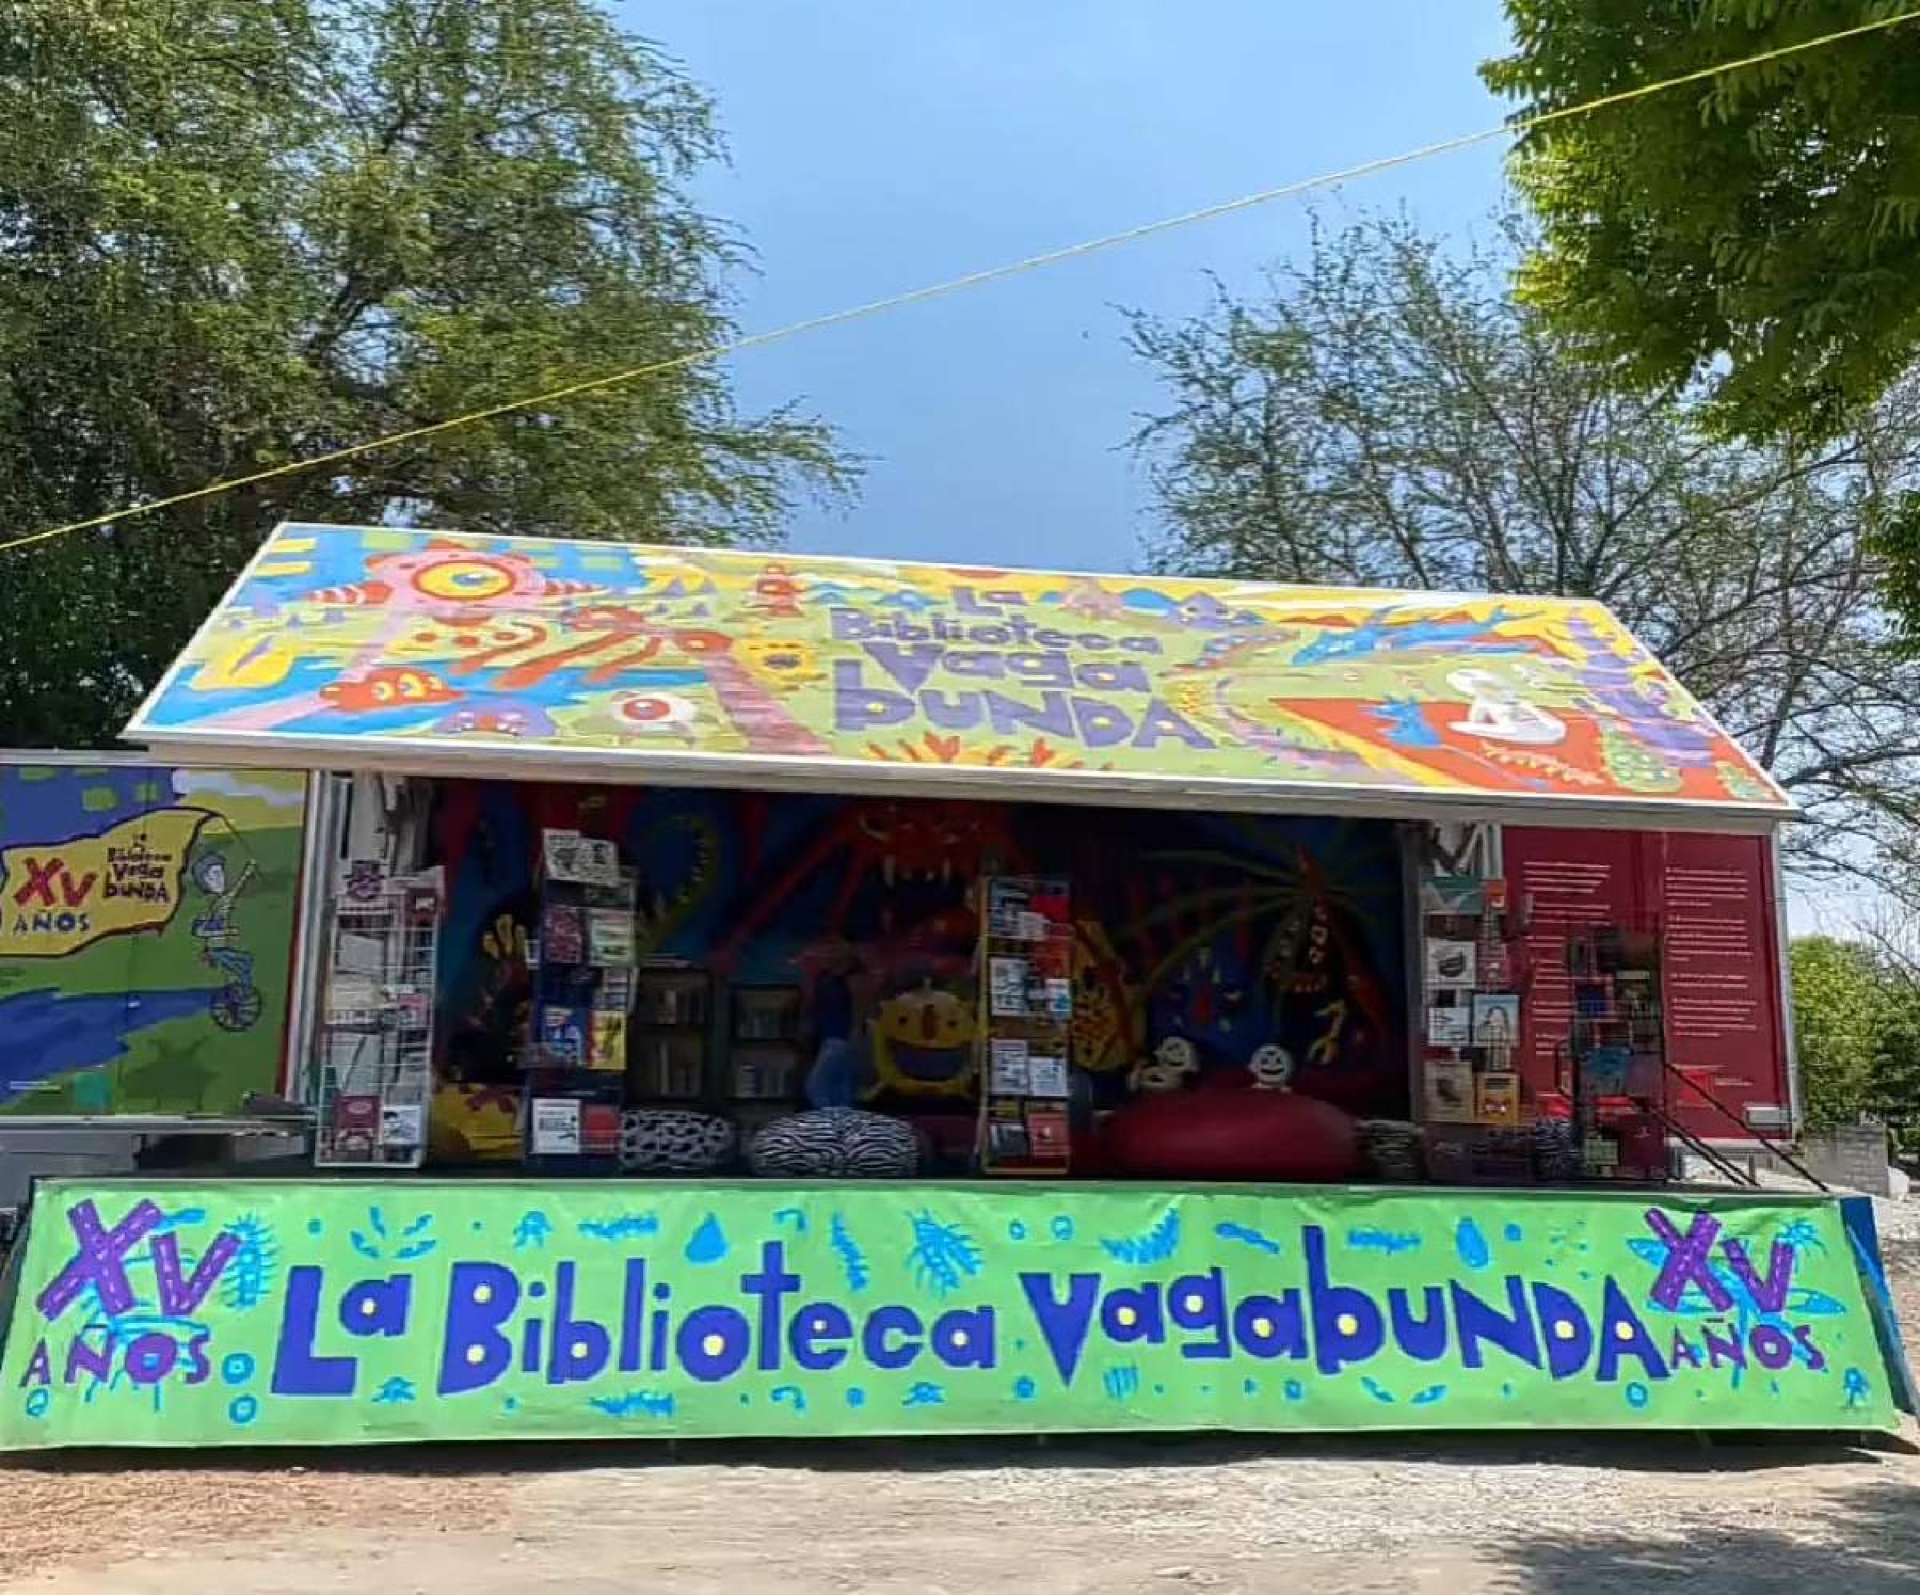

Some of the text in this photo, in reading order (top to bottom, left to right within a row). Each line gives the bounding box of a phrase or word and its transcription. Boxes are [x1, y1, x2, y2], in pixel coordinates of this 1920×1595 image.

[951, 586, 1028, 616] La
[830, 607, 1162, 655] Biblioteca
[861, 642, 1151, 693] Vaga
[14, 857, 98, 906] XV
[13, 908, 91, 937] AÑOS
[35, 1198, 242, 1322] XV
[1644, 1207, 1796, 1312] XV
[271, 1265, 411, 1395] La
[437, 1241, 996, 1397] Biblioteca
[1670, 1318, 1825, 1371] AÑOS
